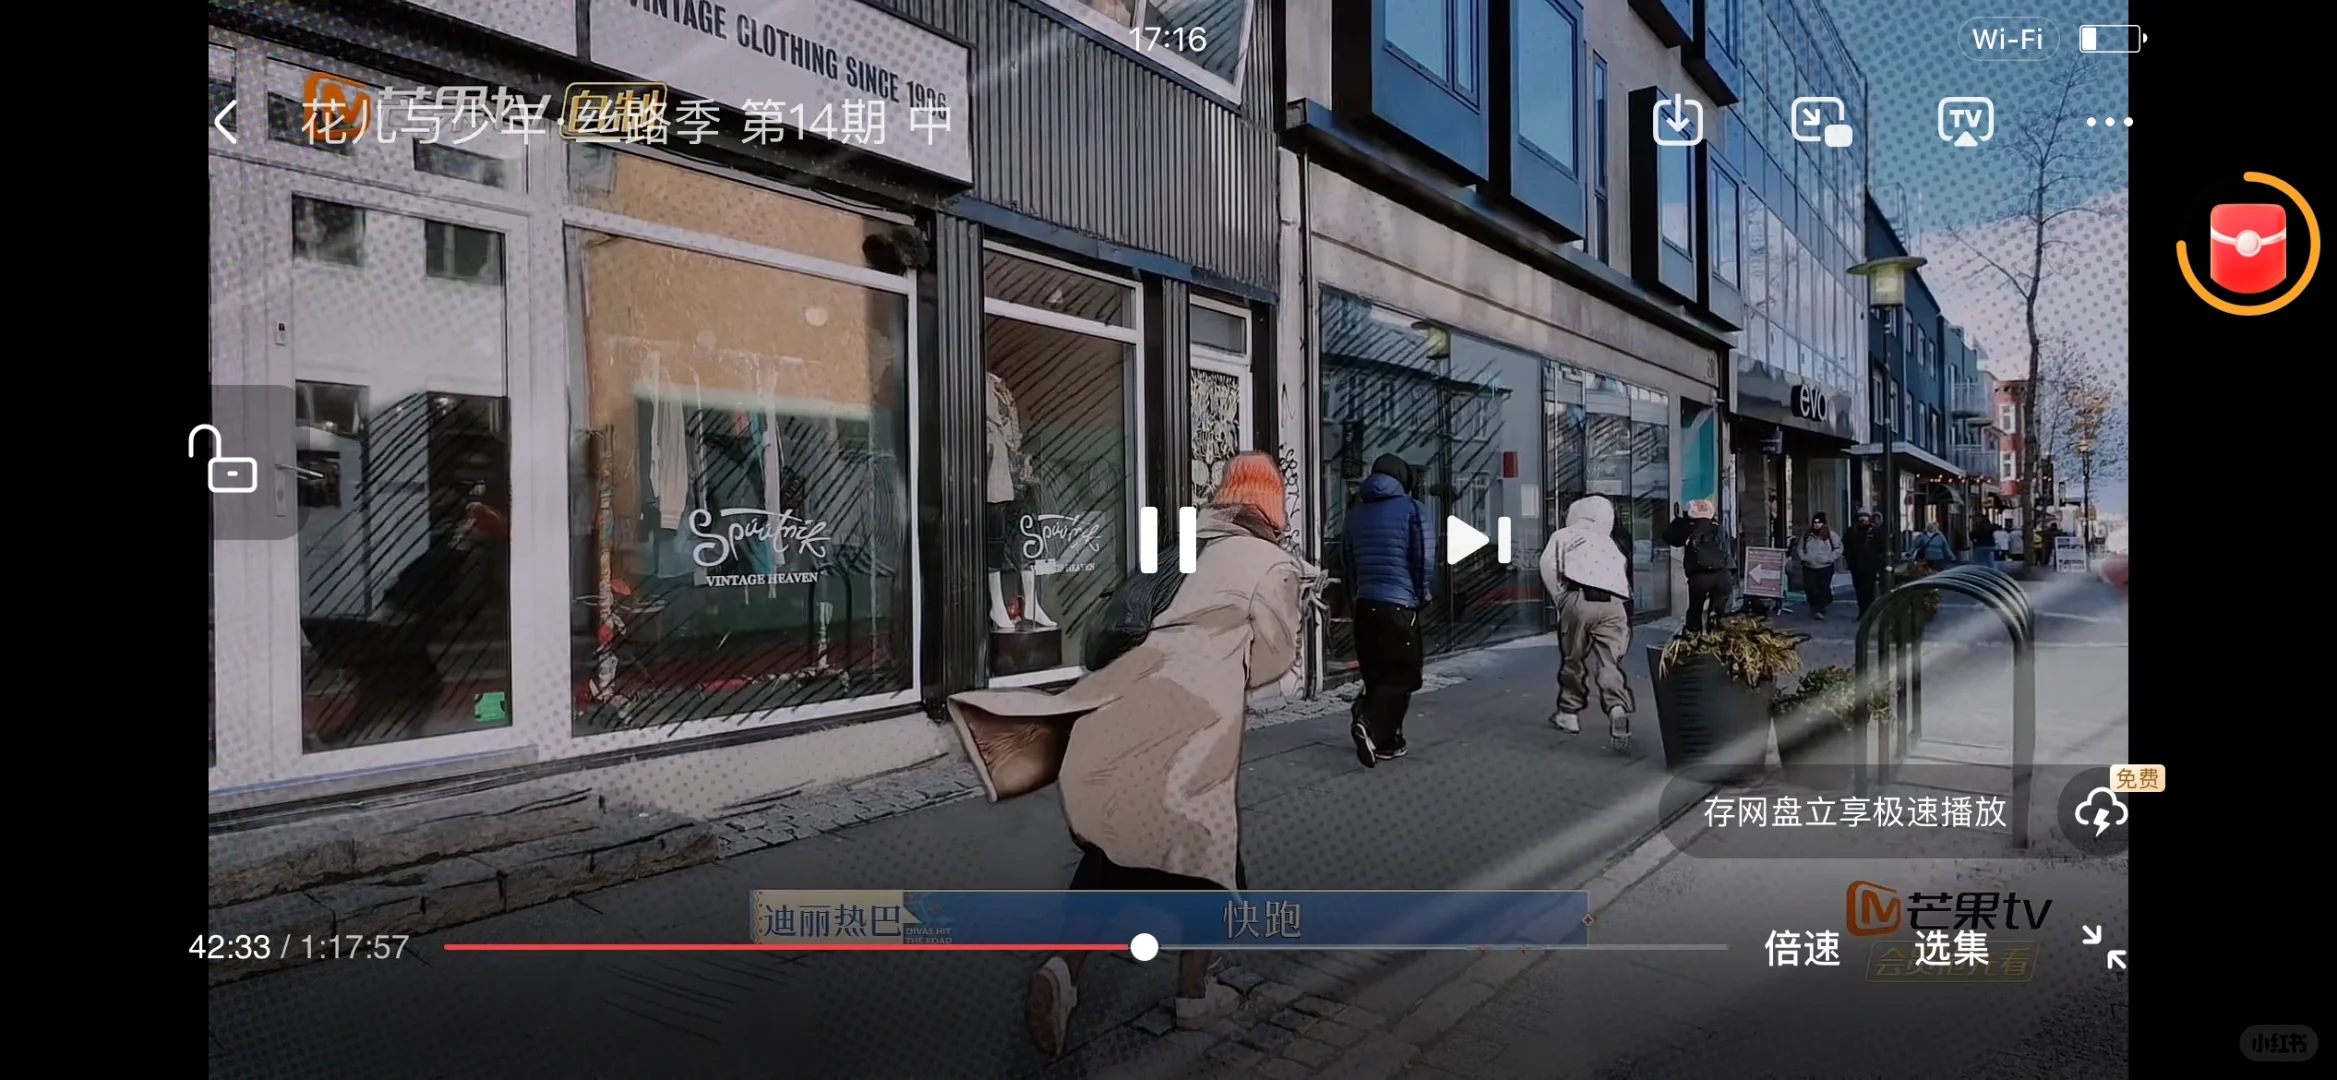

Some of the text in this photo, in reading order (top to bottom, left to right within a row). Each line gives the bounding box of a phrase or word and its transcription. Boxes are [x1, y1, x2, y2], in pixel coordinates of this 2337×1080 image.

[736, 13, 838, 81] CLOTHING
[845, 55, 900, 103] SINCE
[706, 571, 819, 587] VINTAGE HEAVEN
